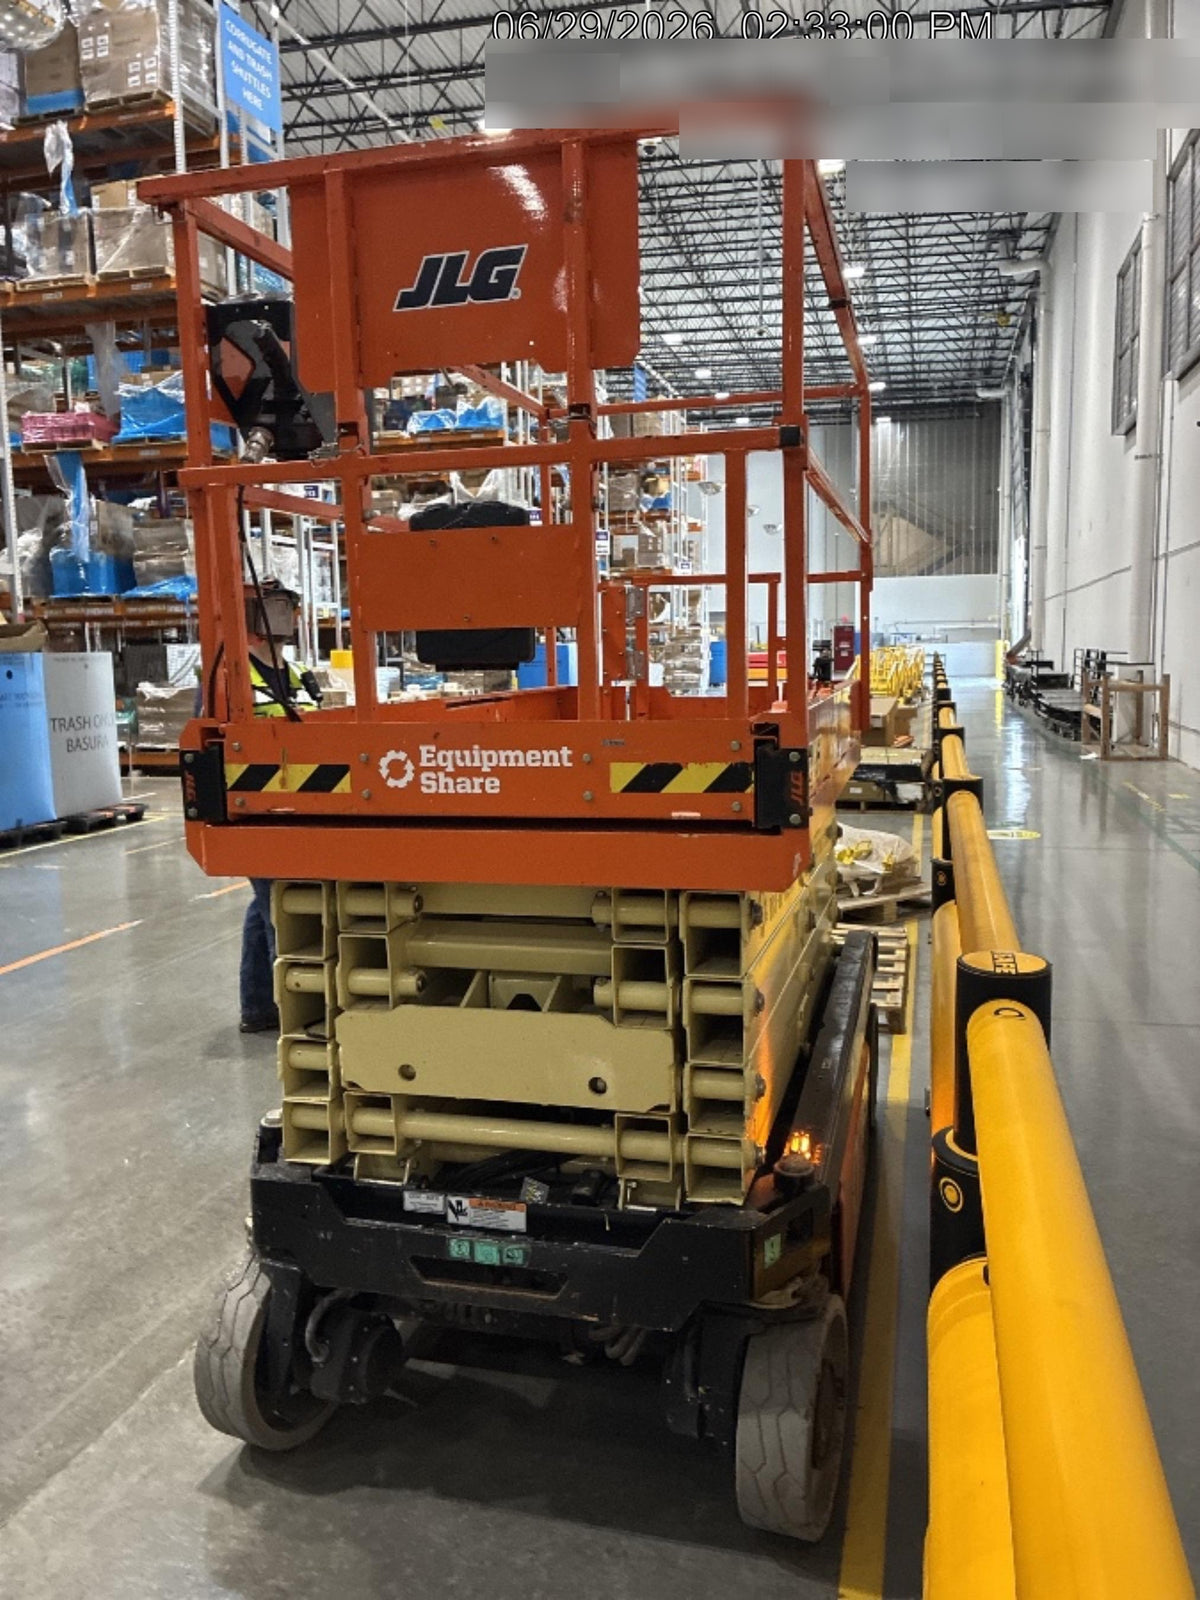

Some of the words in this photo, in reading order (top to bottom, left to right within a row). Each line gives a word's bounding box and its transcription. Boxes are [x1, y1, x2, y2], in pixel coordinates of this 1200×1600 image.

[231, 60, 271, 98] SHUTTLES
[243, 87, 264, 111] HERE
[392, 243, 529, 312] JLG
[49, 715, 92, 733] TRASH
[419, 744, 573, 772] Equipment
[420, 771, 500, 794] Share
